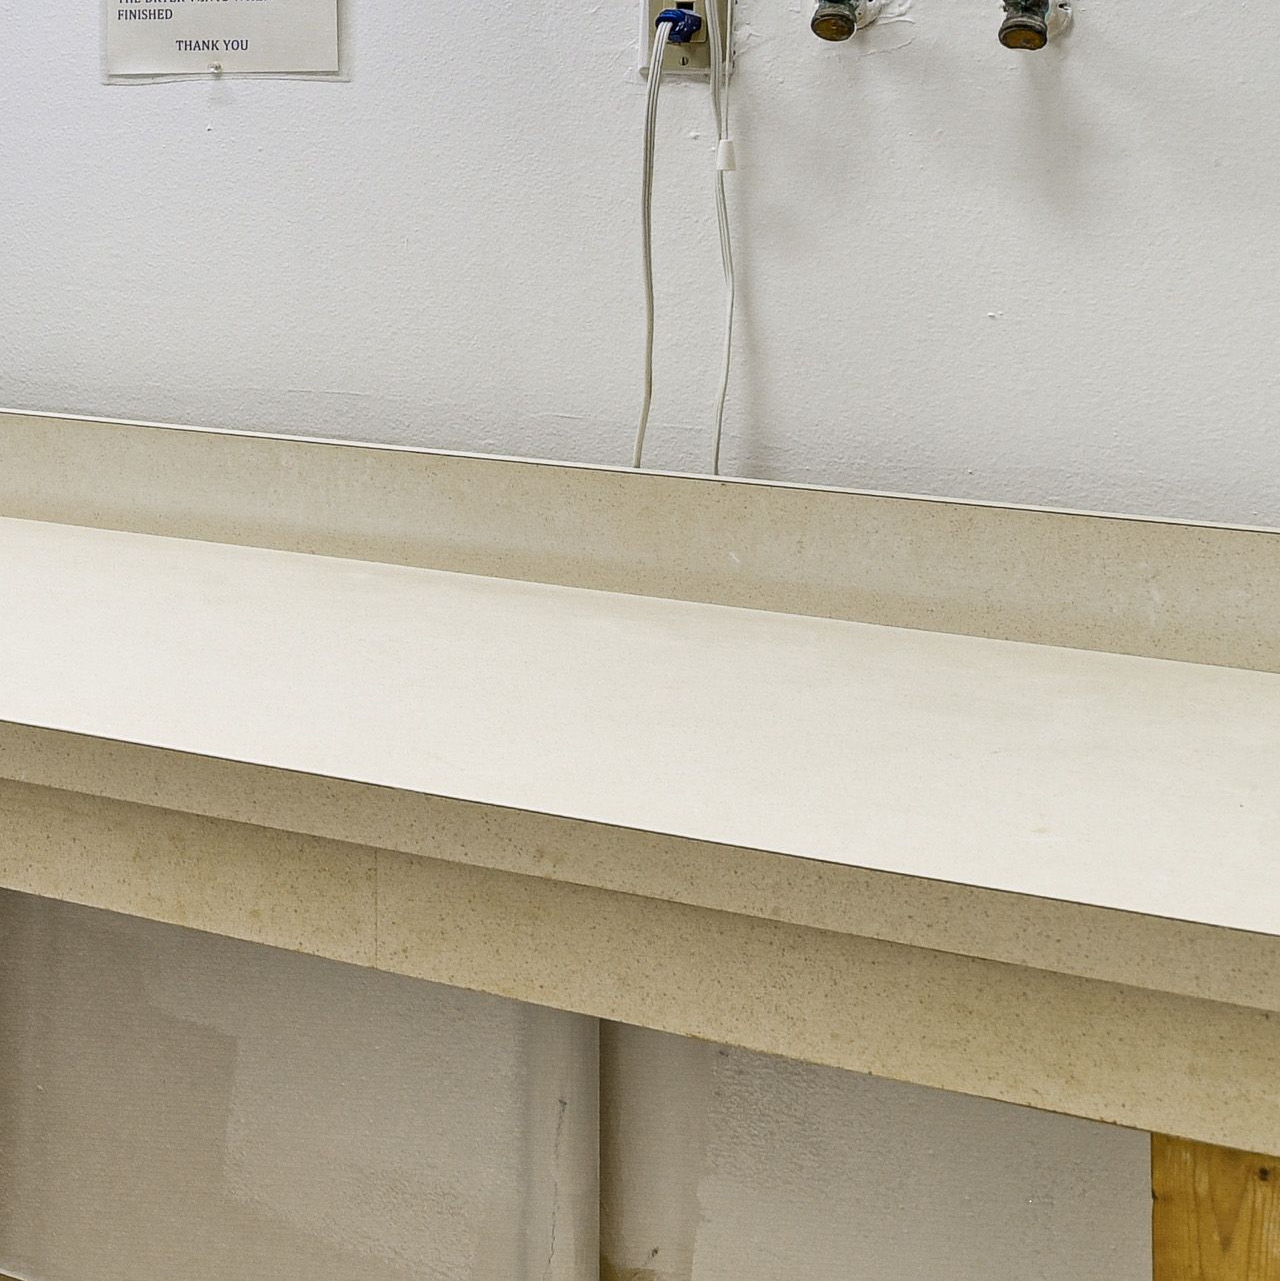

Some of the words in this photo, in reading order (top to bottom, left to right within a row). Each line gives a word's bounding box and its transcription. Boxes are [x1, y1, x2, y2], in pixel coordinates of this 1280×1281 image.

[118, 8, 173, 20] FINISHED
[176, 40, 219, 51] THANK
[223, 39, 249, 50] YOU
